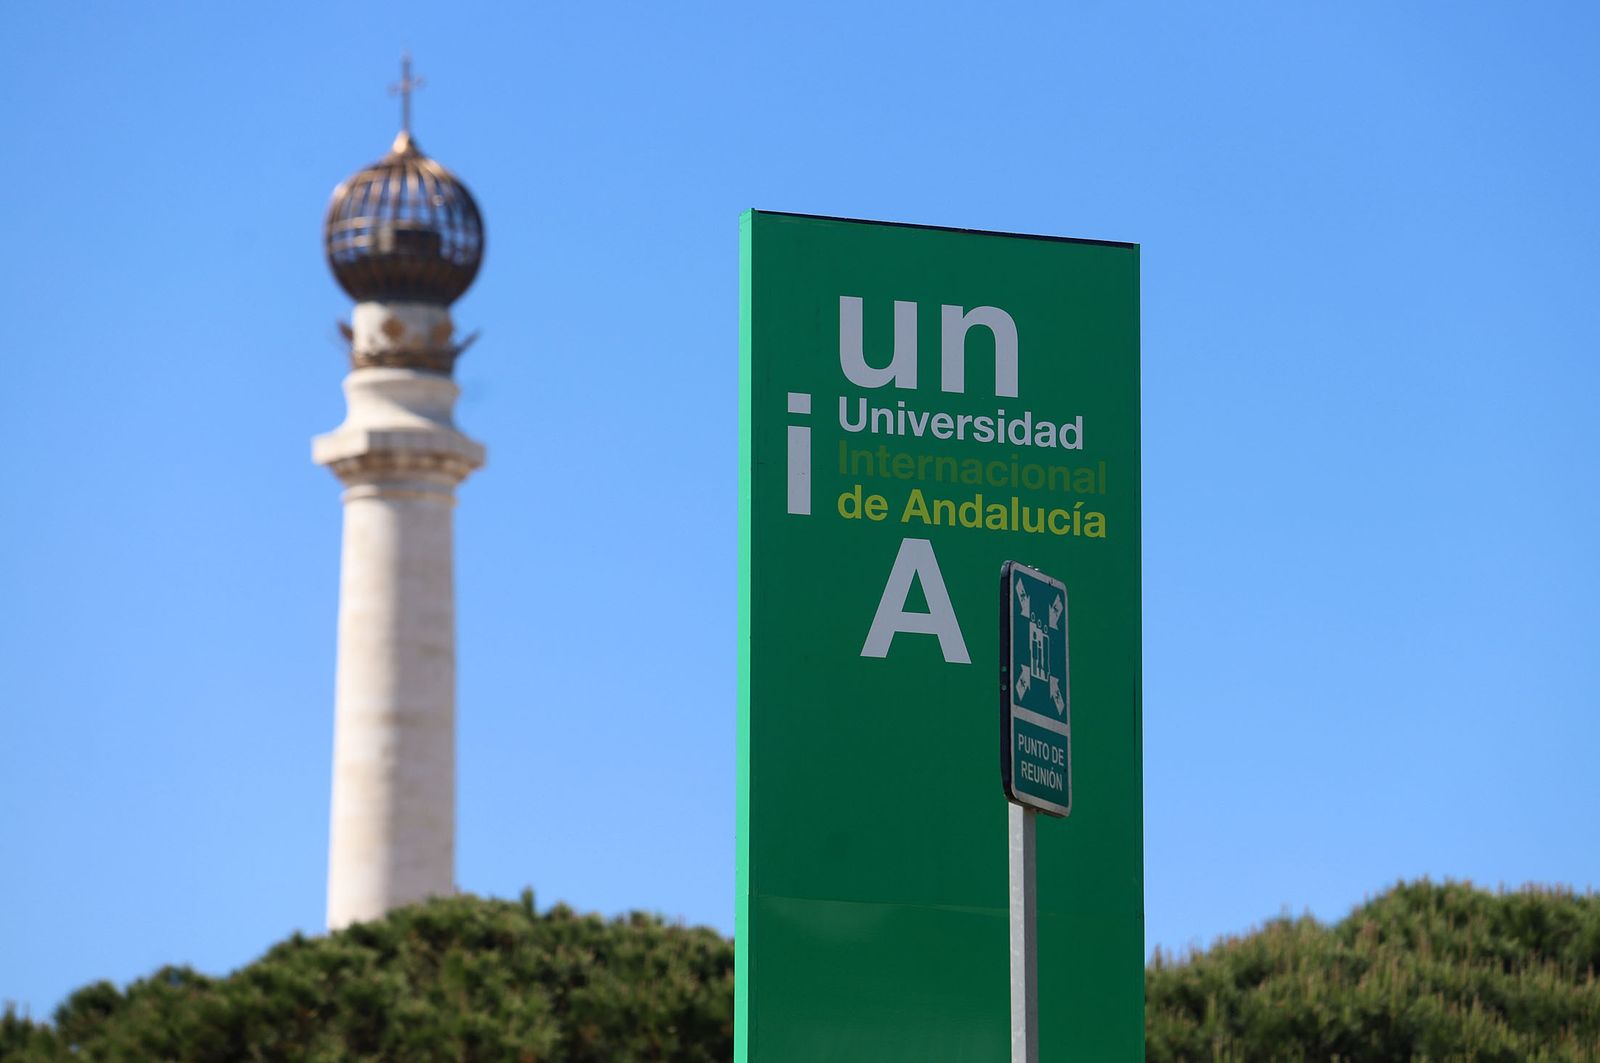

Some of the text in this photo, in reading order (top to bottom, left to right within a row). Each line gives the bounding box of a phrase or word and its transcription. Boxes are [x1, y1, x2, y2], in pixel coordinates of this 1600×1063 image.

[839, 295, 1018, 398] un
[838, 396, 1084, 450] Universidad
[787, 392, 811, 515] i
[838, 440, 1106, 494] Internacional
[837, 485, 1106, 538] de Andalucía
[860, 538, 972, 664] A
[1018, 733, 1064, 766] PUNTO DE
[1021, 760, 1063, 792] REUNIÓN
